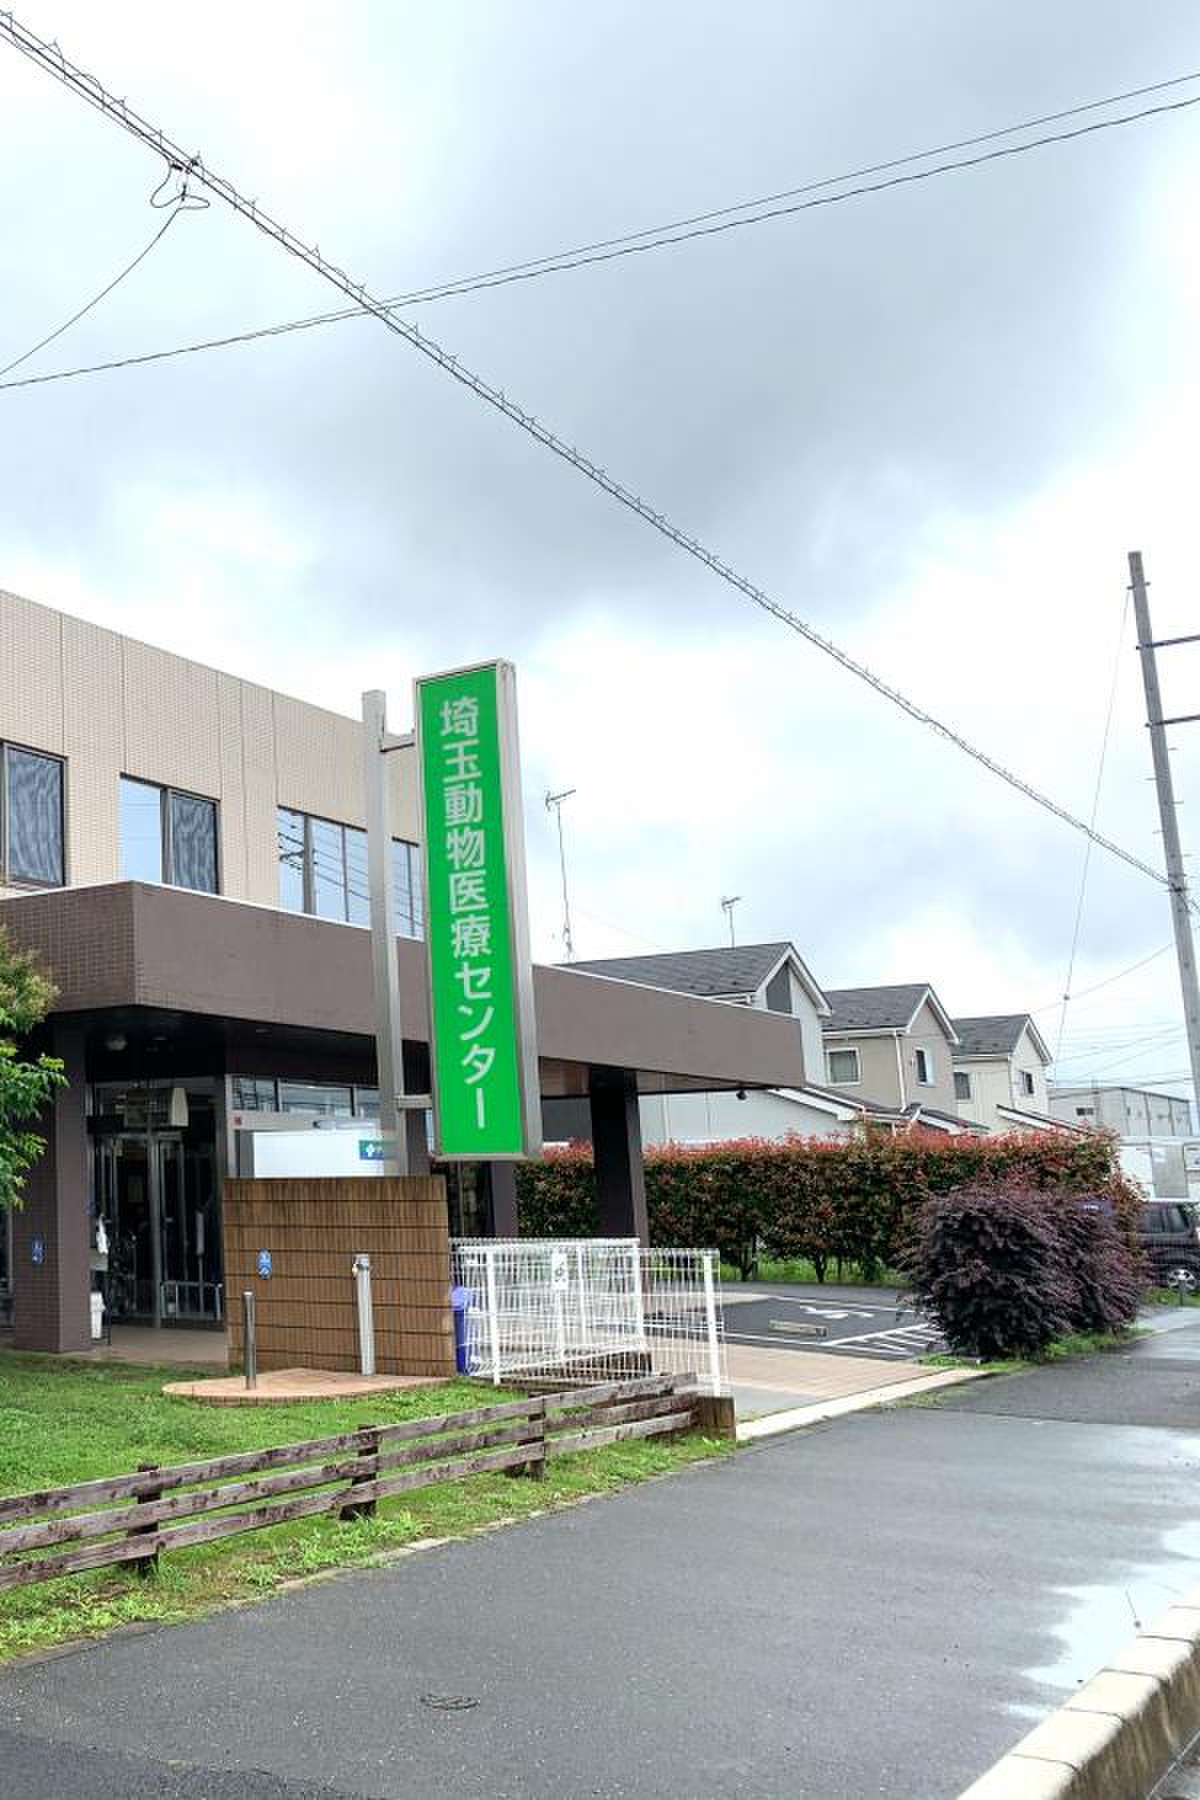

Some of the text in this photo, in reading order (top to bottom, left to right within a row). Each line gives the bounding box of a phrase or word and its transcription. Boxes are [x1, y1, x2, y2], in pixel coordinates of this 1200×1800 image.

[439, 696, 496, 1129] 埼玉動物医療センター
